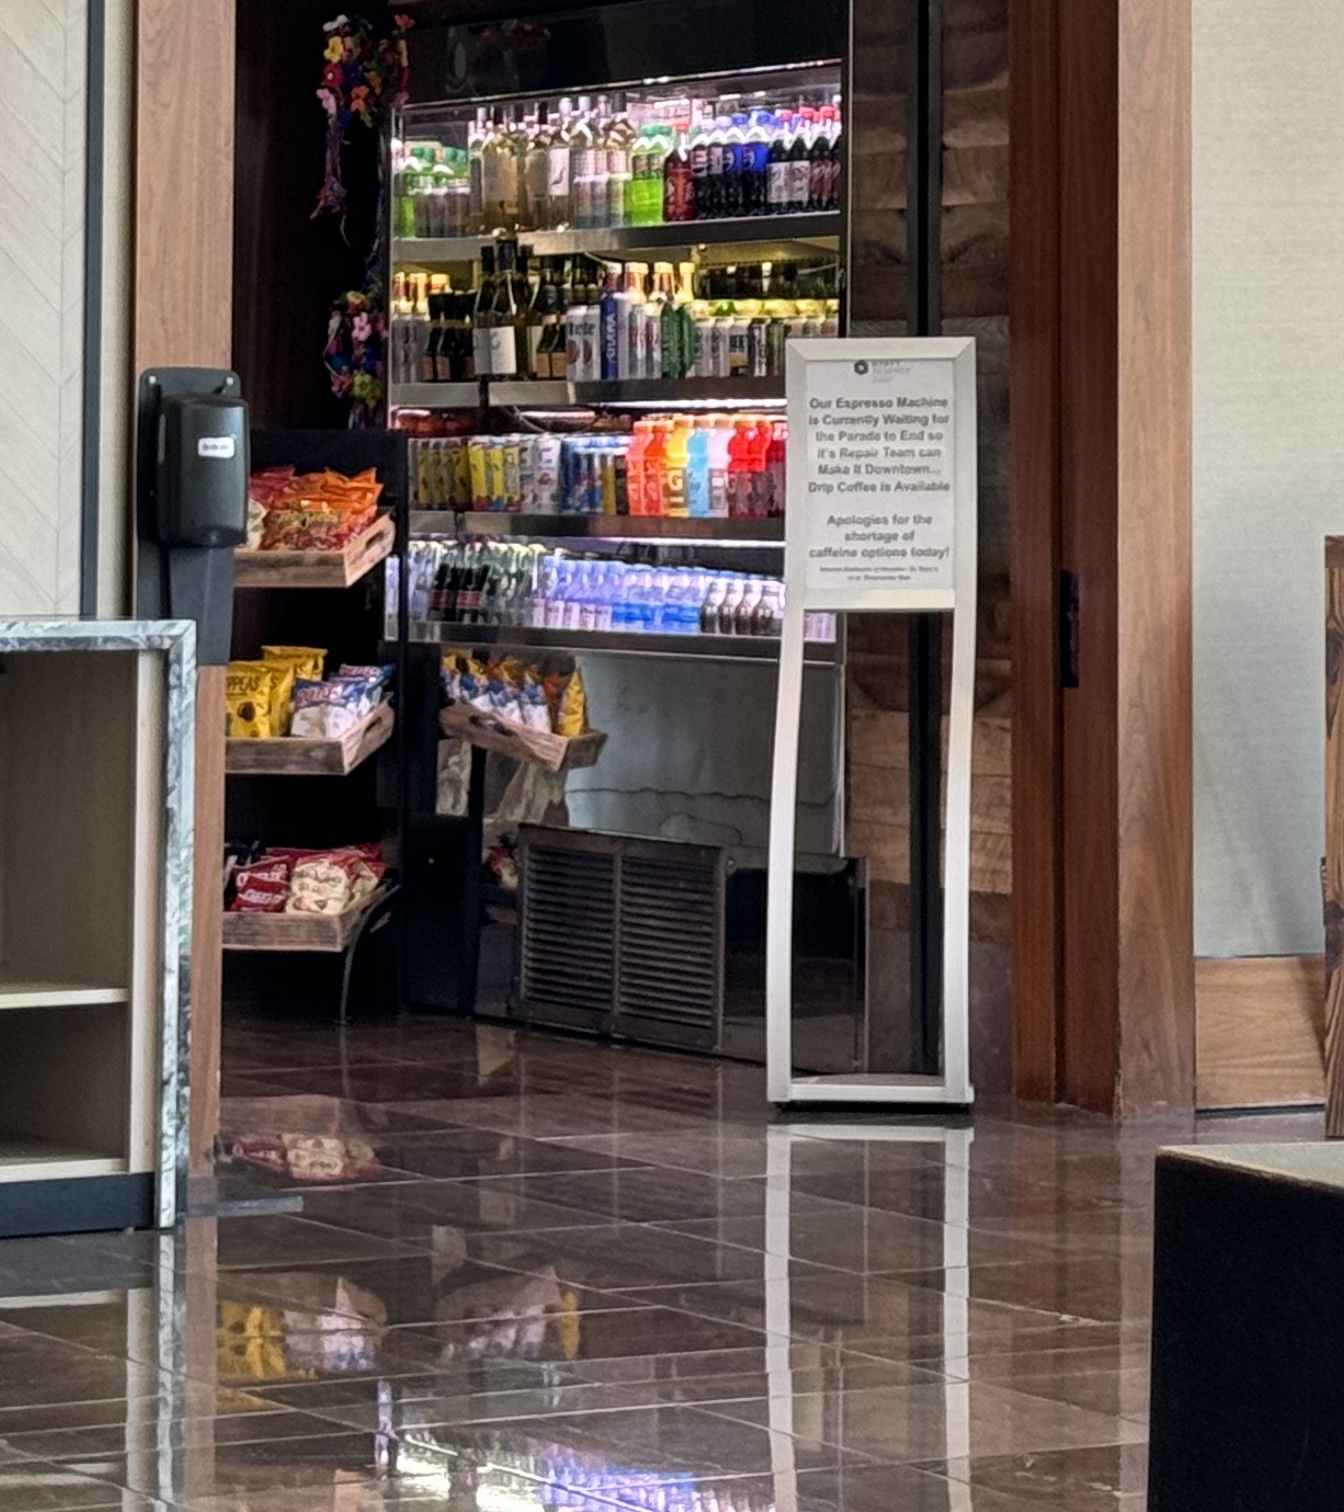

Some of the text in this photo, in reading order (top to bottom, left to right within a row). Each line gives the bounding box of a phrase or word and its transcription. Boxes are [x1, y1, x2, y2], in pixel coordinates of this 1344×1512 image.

[809, 396, 948, 410] Our Espresso Machine
[822, 414, 879, 427] Currently
[882, 413, 929, 427] Waiting
[932, 413, 950, 424] for
[816, 430, 944, 442] the Parade to End so
[839, 447, 879, 461] Repair
[883, 446, 915, 458] Team
[918, 448, 941, 457] can
[818, 464, 850, 475] Make
[808, 481, 835, 495] Drip
[837, 481, 877, 492] Coffee
[894, 481, 950, 492] Available
[827, 513, 933, 528] Apologies for the
[844, 529, 915, 544] shortage of
[808, 546, 858, 558] caffeine
[861, 547, 908, 559] options
